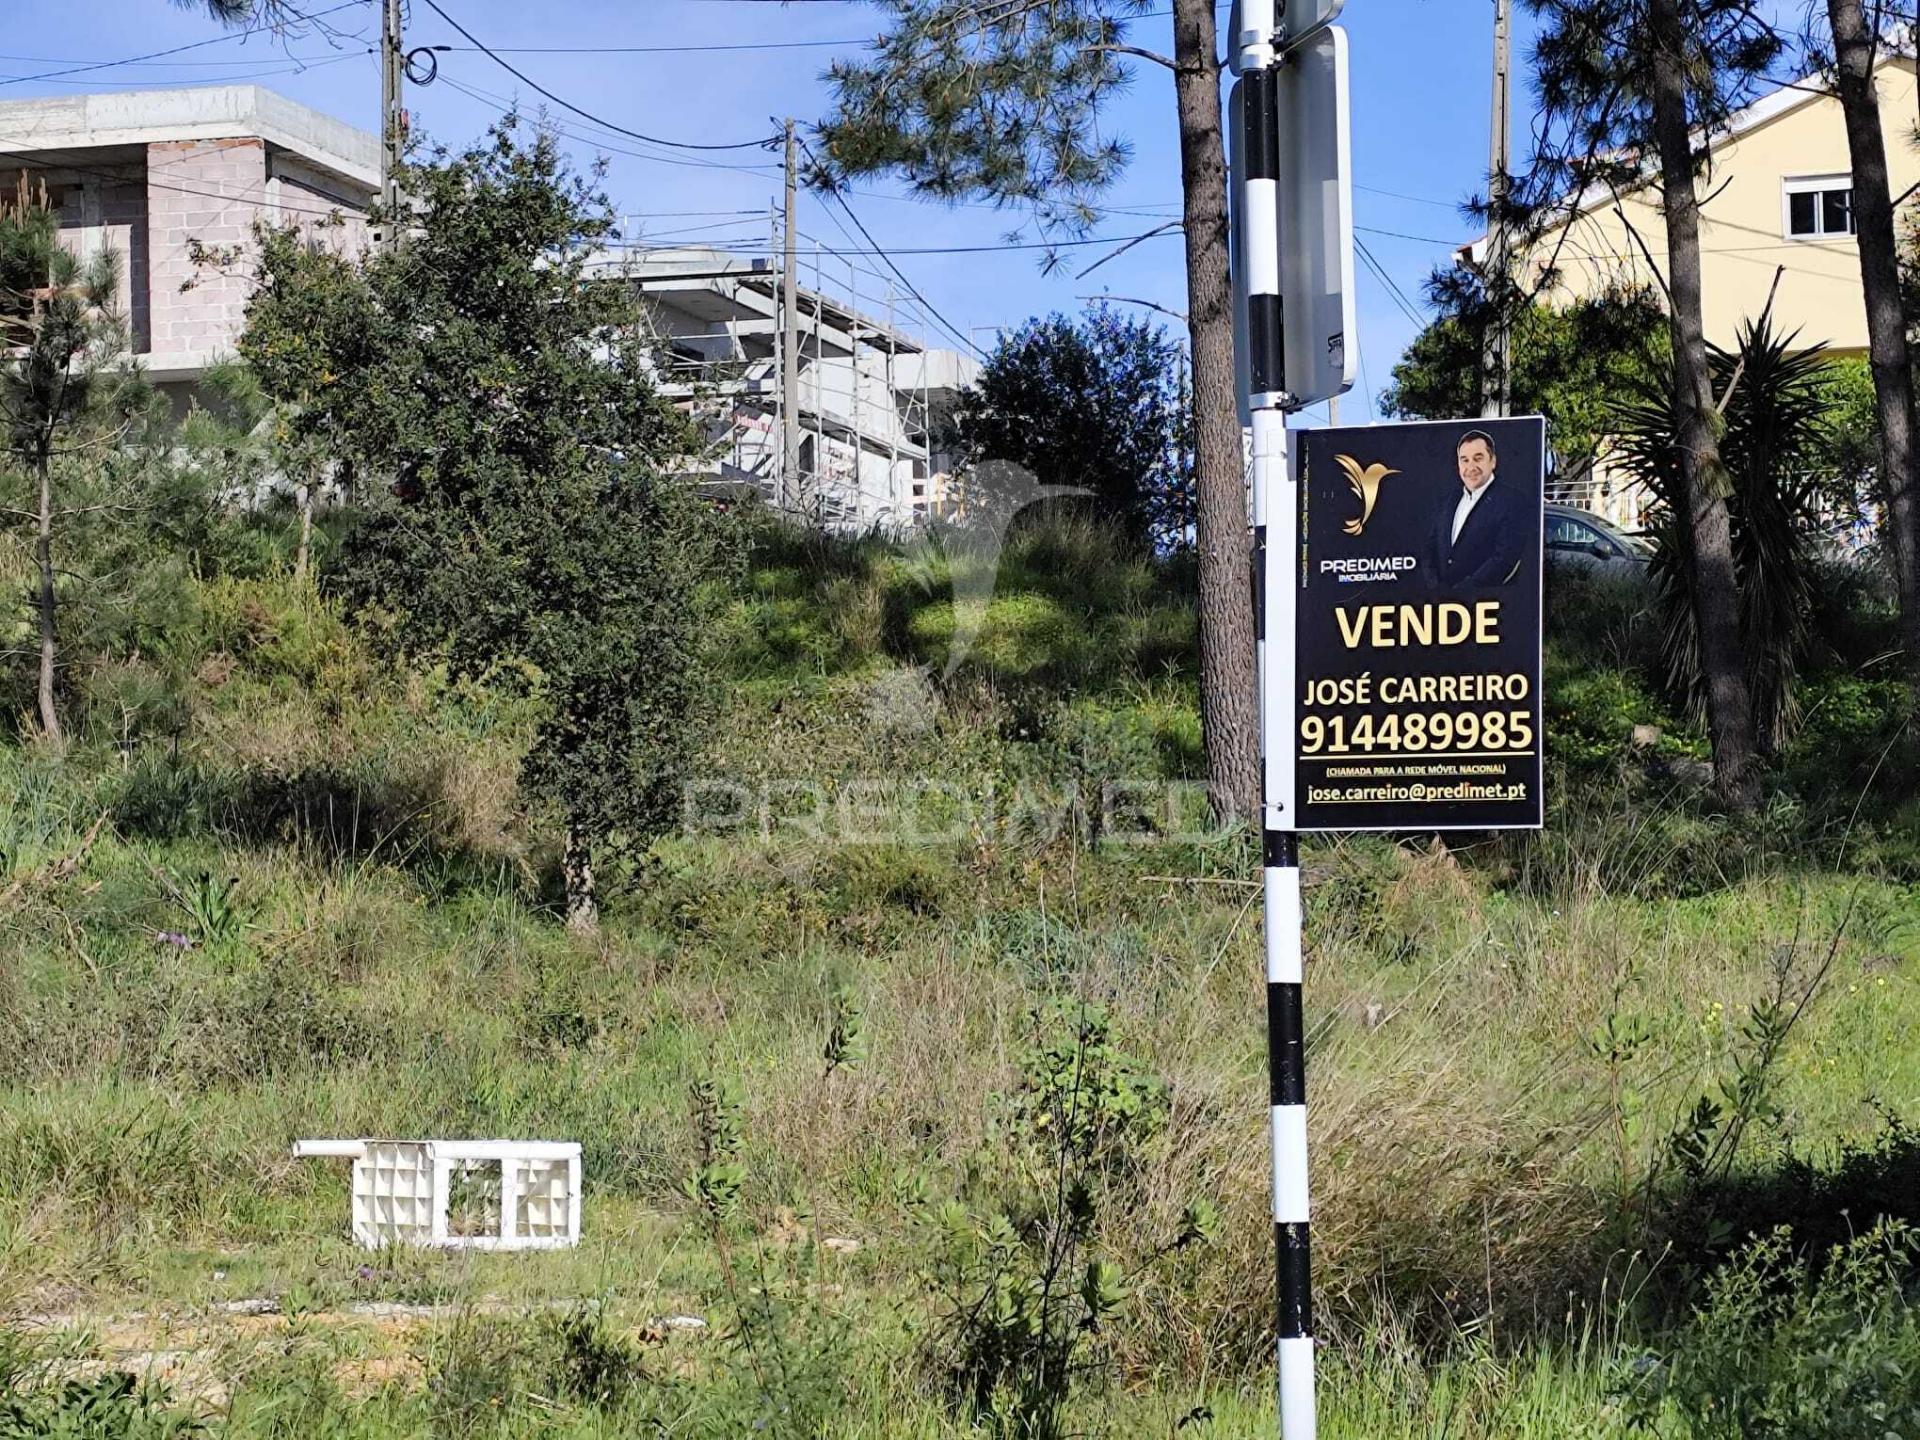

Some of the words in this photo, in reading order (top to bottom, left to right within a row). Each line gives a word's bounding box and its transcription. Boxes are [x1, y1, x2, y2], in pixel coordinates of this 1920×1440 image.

[1320, 556, 1417, 573] PREDIMED
[1335, 601, 1500, 649] VENDE
[1303, 671, 1371, 706] JOSÉ
[1379, 673, 1529, 704] CARREIRO
[1300, 711, 1533, 754] 914489985
[1326, 767, 1372, 778] (CHAMADA
[1373, 766, 1396, 777] PARA
[1396, 765, 1404, 776] A
[1404, 764, 1427, 776] REDE
[1428, 763, 1458, 775] MÓVEL
[1459, 762, 1507, 775] NACIONAL)
[1307, 782, 1527, 805] jose.carreiro@predimet.pt
